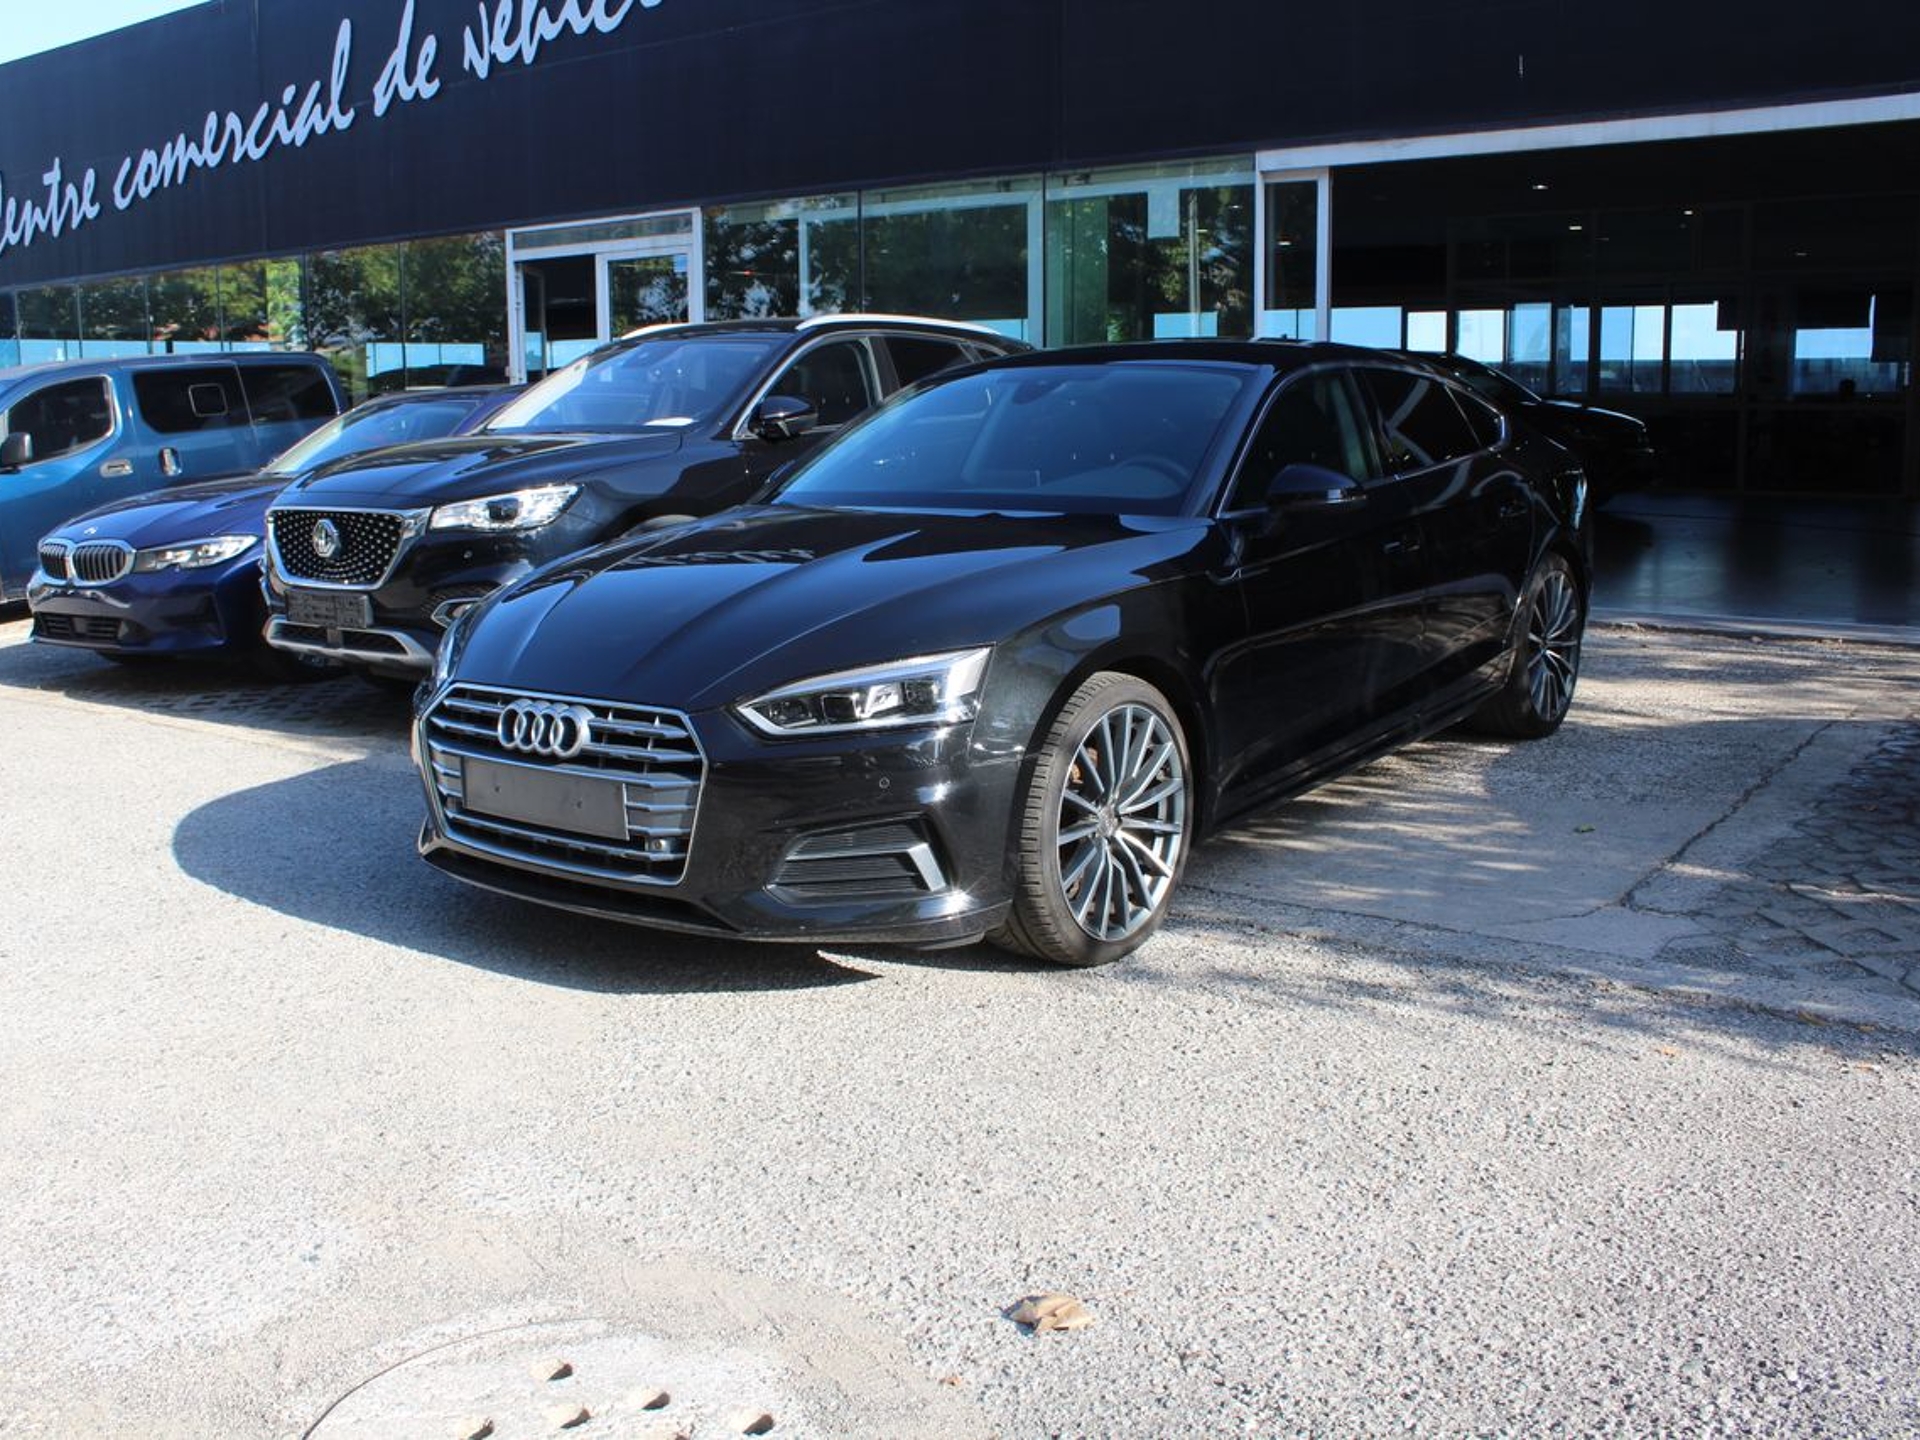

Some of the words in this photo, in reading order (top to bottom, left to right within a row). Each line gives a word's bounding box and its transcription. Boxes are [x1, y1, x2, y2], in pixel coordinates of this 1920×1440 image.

[0, 157, 100, 252] entre
[113, 18, 355, 210] comercial
[373, 0, 440, 117] de
